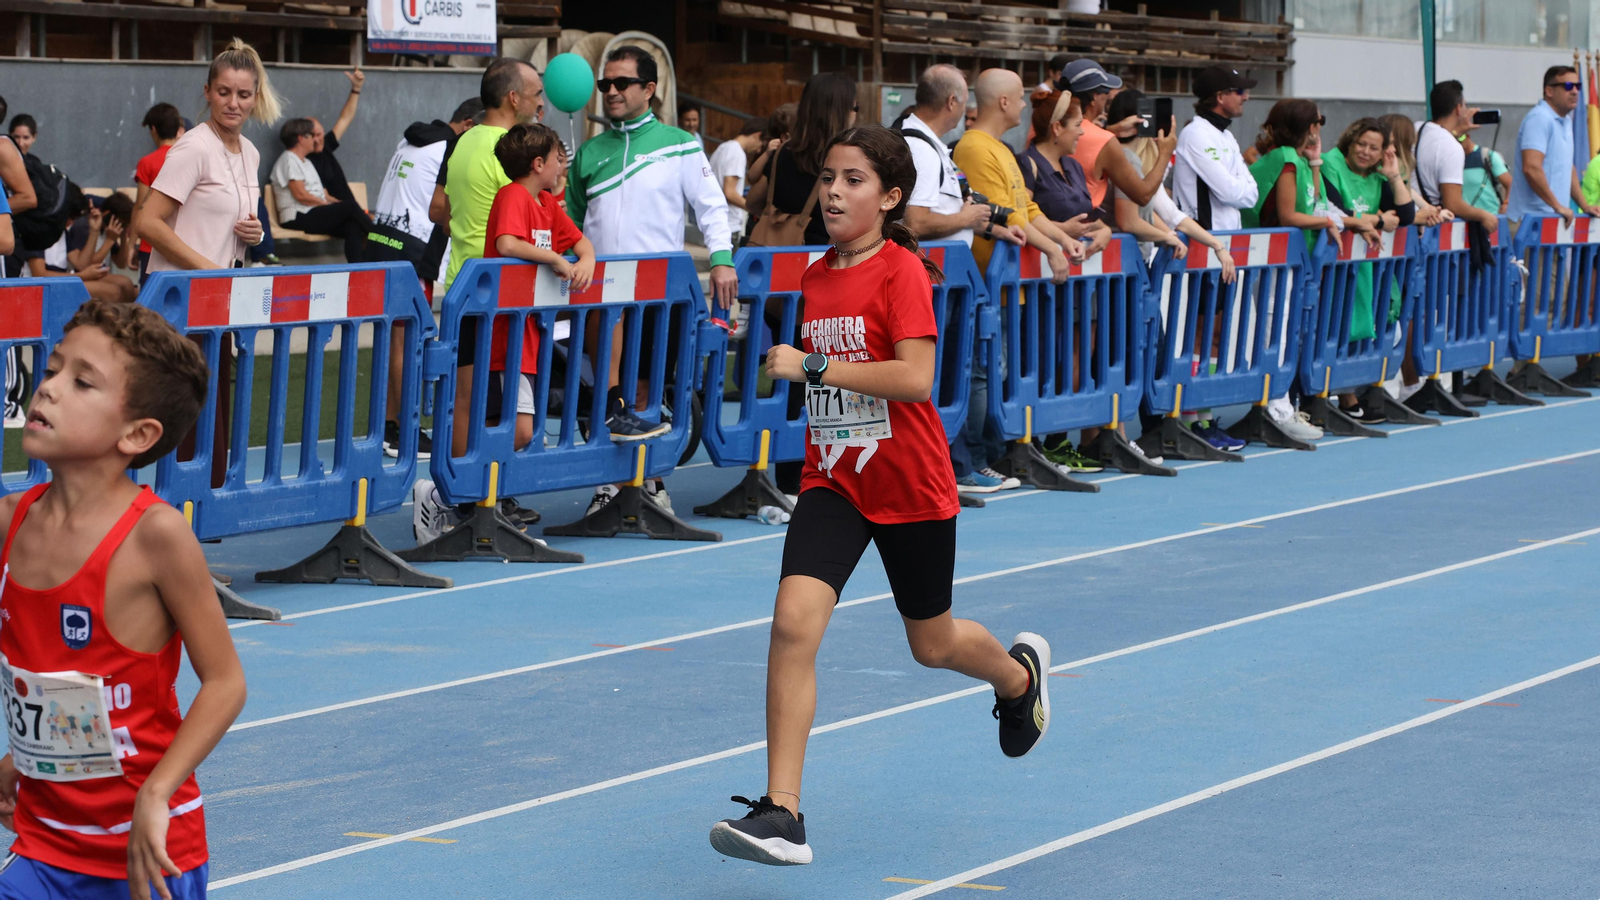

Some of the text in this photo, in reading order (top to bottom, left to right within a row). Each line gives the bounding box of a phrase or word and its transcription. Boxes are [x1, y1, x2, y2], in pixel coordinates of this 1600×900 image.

[424, 1, 463, 18] CARBIS
[810, 316, 866, 338] CARRERA
[810, 333, 867, 354] POPULAR
[806, 388, 844, 417] 1771
[26, 743, 55, 752] ZAMBRANO
